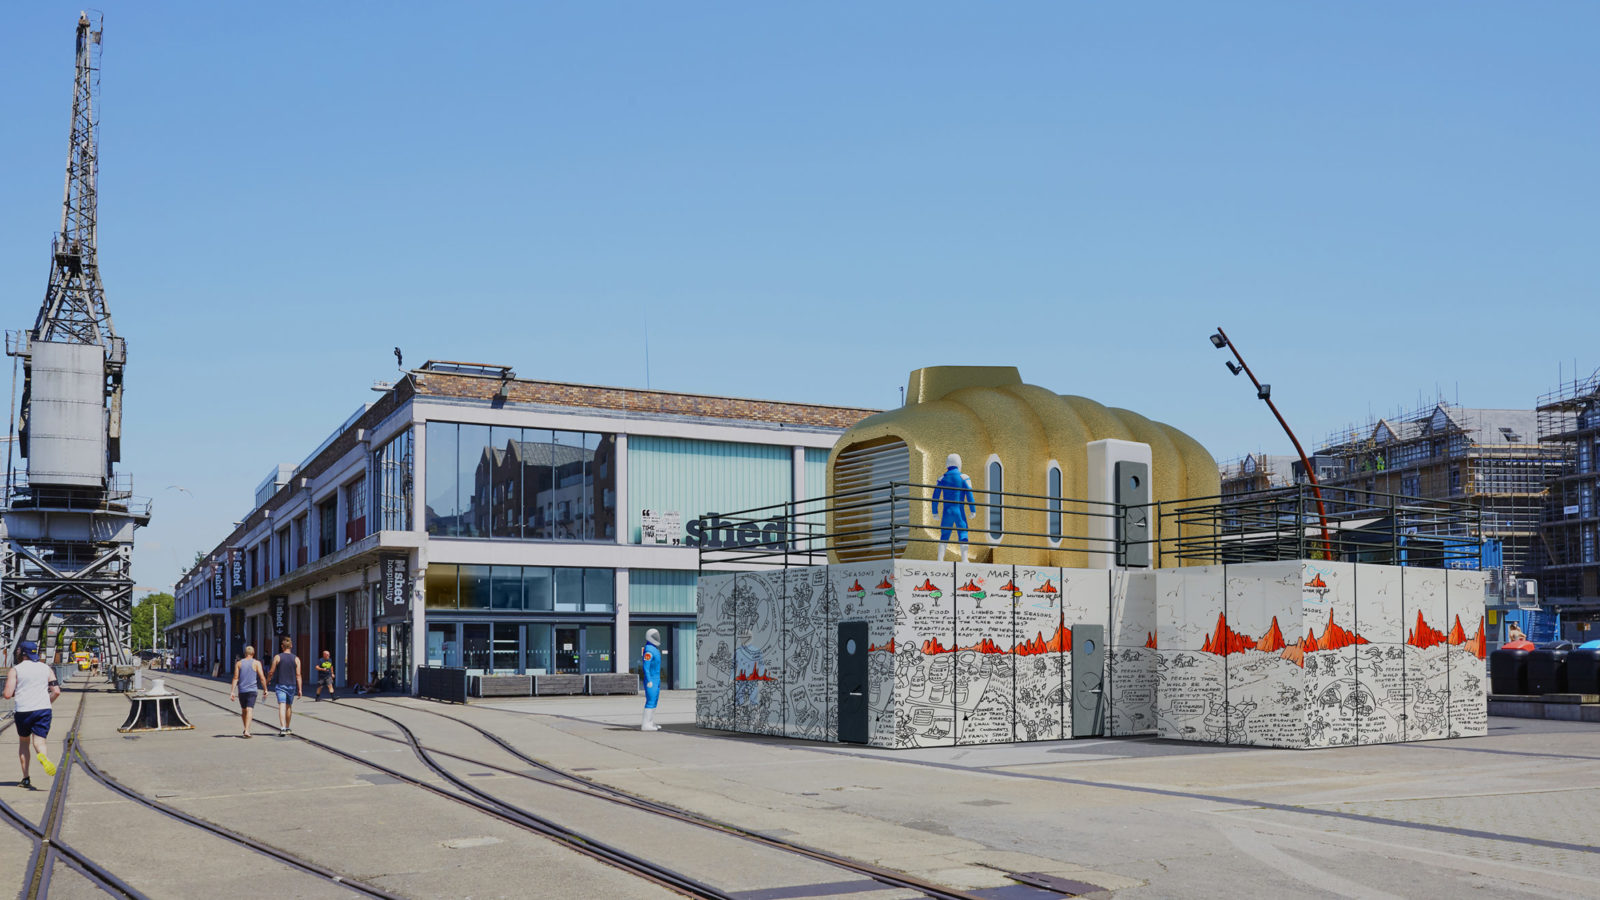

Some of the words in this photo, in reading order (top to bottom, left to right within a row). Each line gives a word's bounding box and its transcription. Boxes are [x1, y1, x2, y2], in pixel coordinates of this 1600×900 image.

[686, 512, 789, 550] shed
[233, 561, 243, 586] shed
[386, 560, 394, 602] hospitality
[841, 569, 875, 579] SEASONS
[904, 568, 955, 578] SEASONS
[987, 570, 1019, 578] MARS
[394, 572, 405, 605] shed
